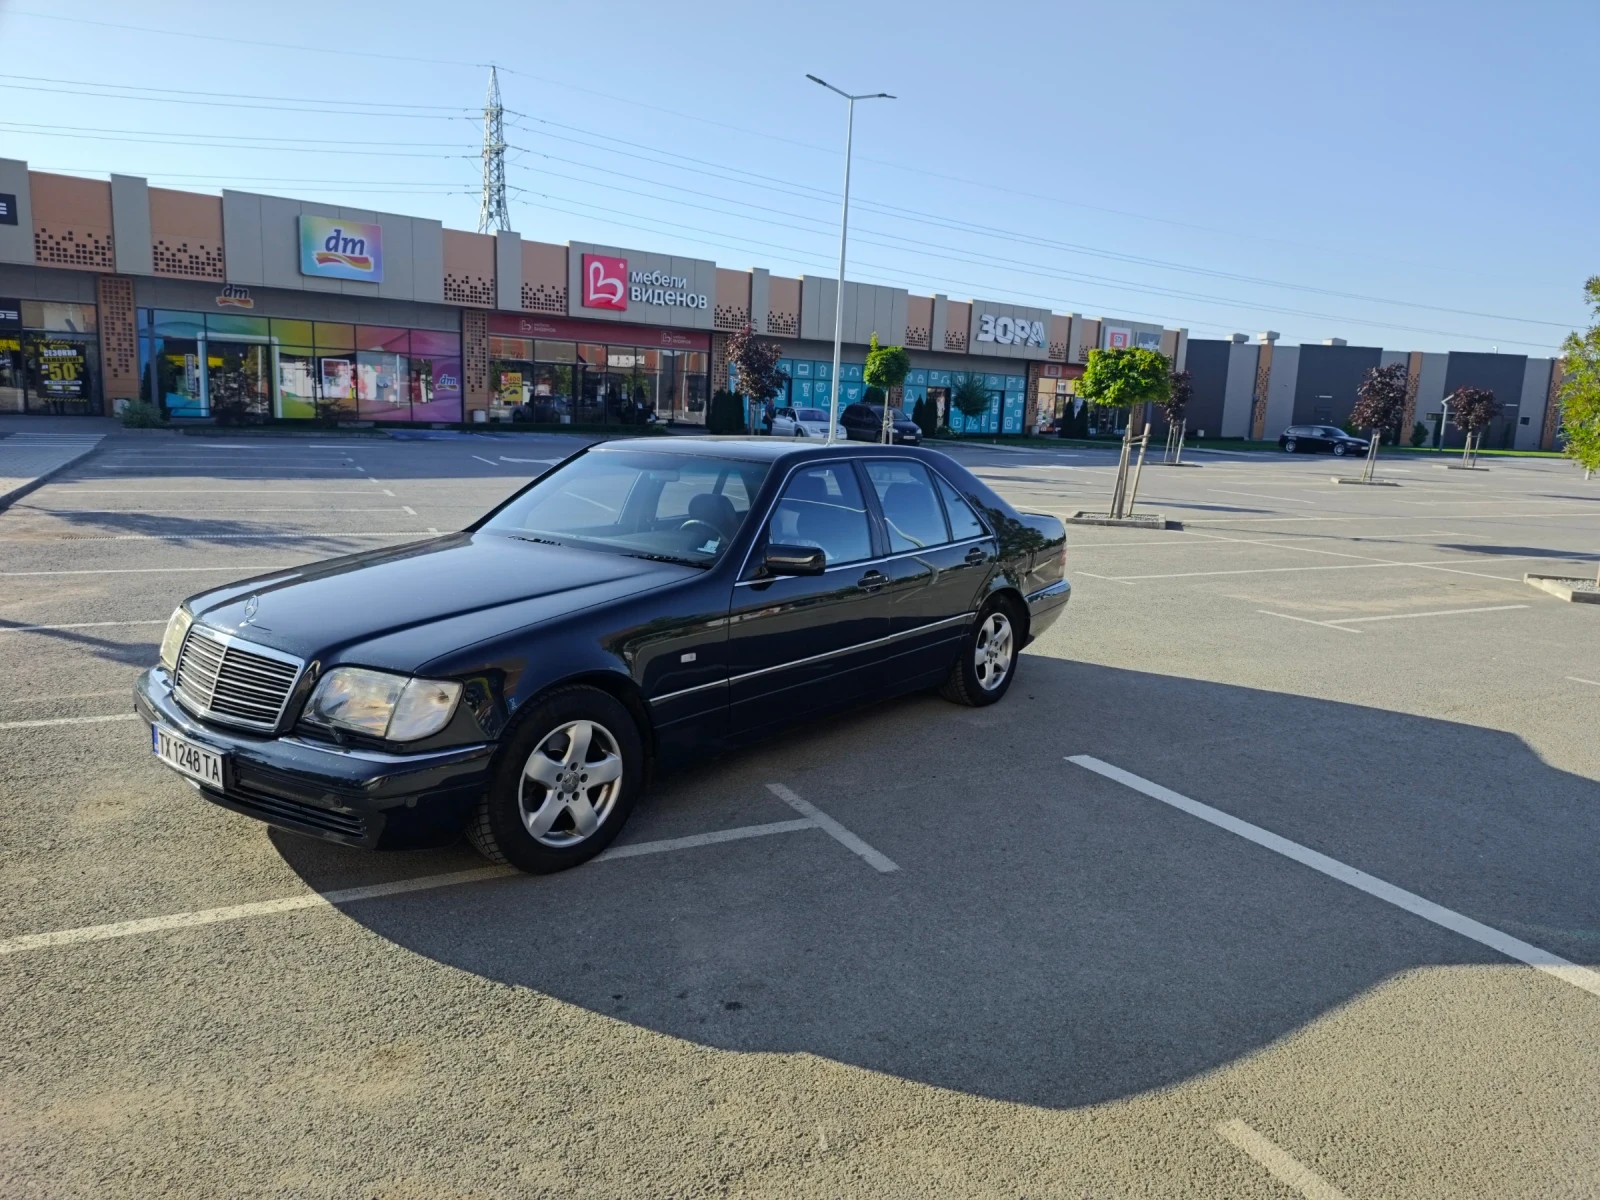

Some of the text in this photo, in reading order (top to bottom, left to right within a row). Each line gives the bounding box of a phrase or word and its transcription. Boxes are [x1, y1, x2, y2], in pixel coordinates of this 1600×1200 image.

[325, 229, 365, 255] dm
[631, 270, 687, 289] мебели
[223, 284, 248, 299] dm
[976, 314, 1047, 348] ЗОРА
[440, 374, 456, 385] dm
[174, 741, 201, 773] 1248
[202, 753, 220, 782] TA
